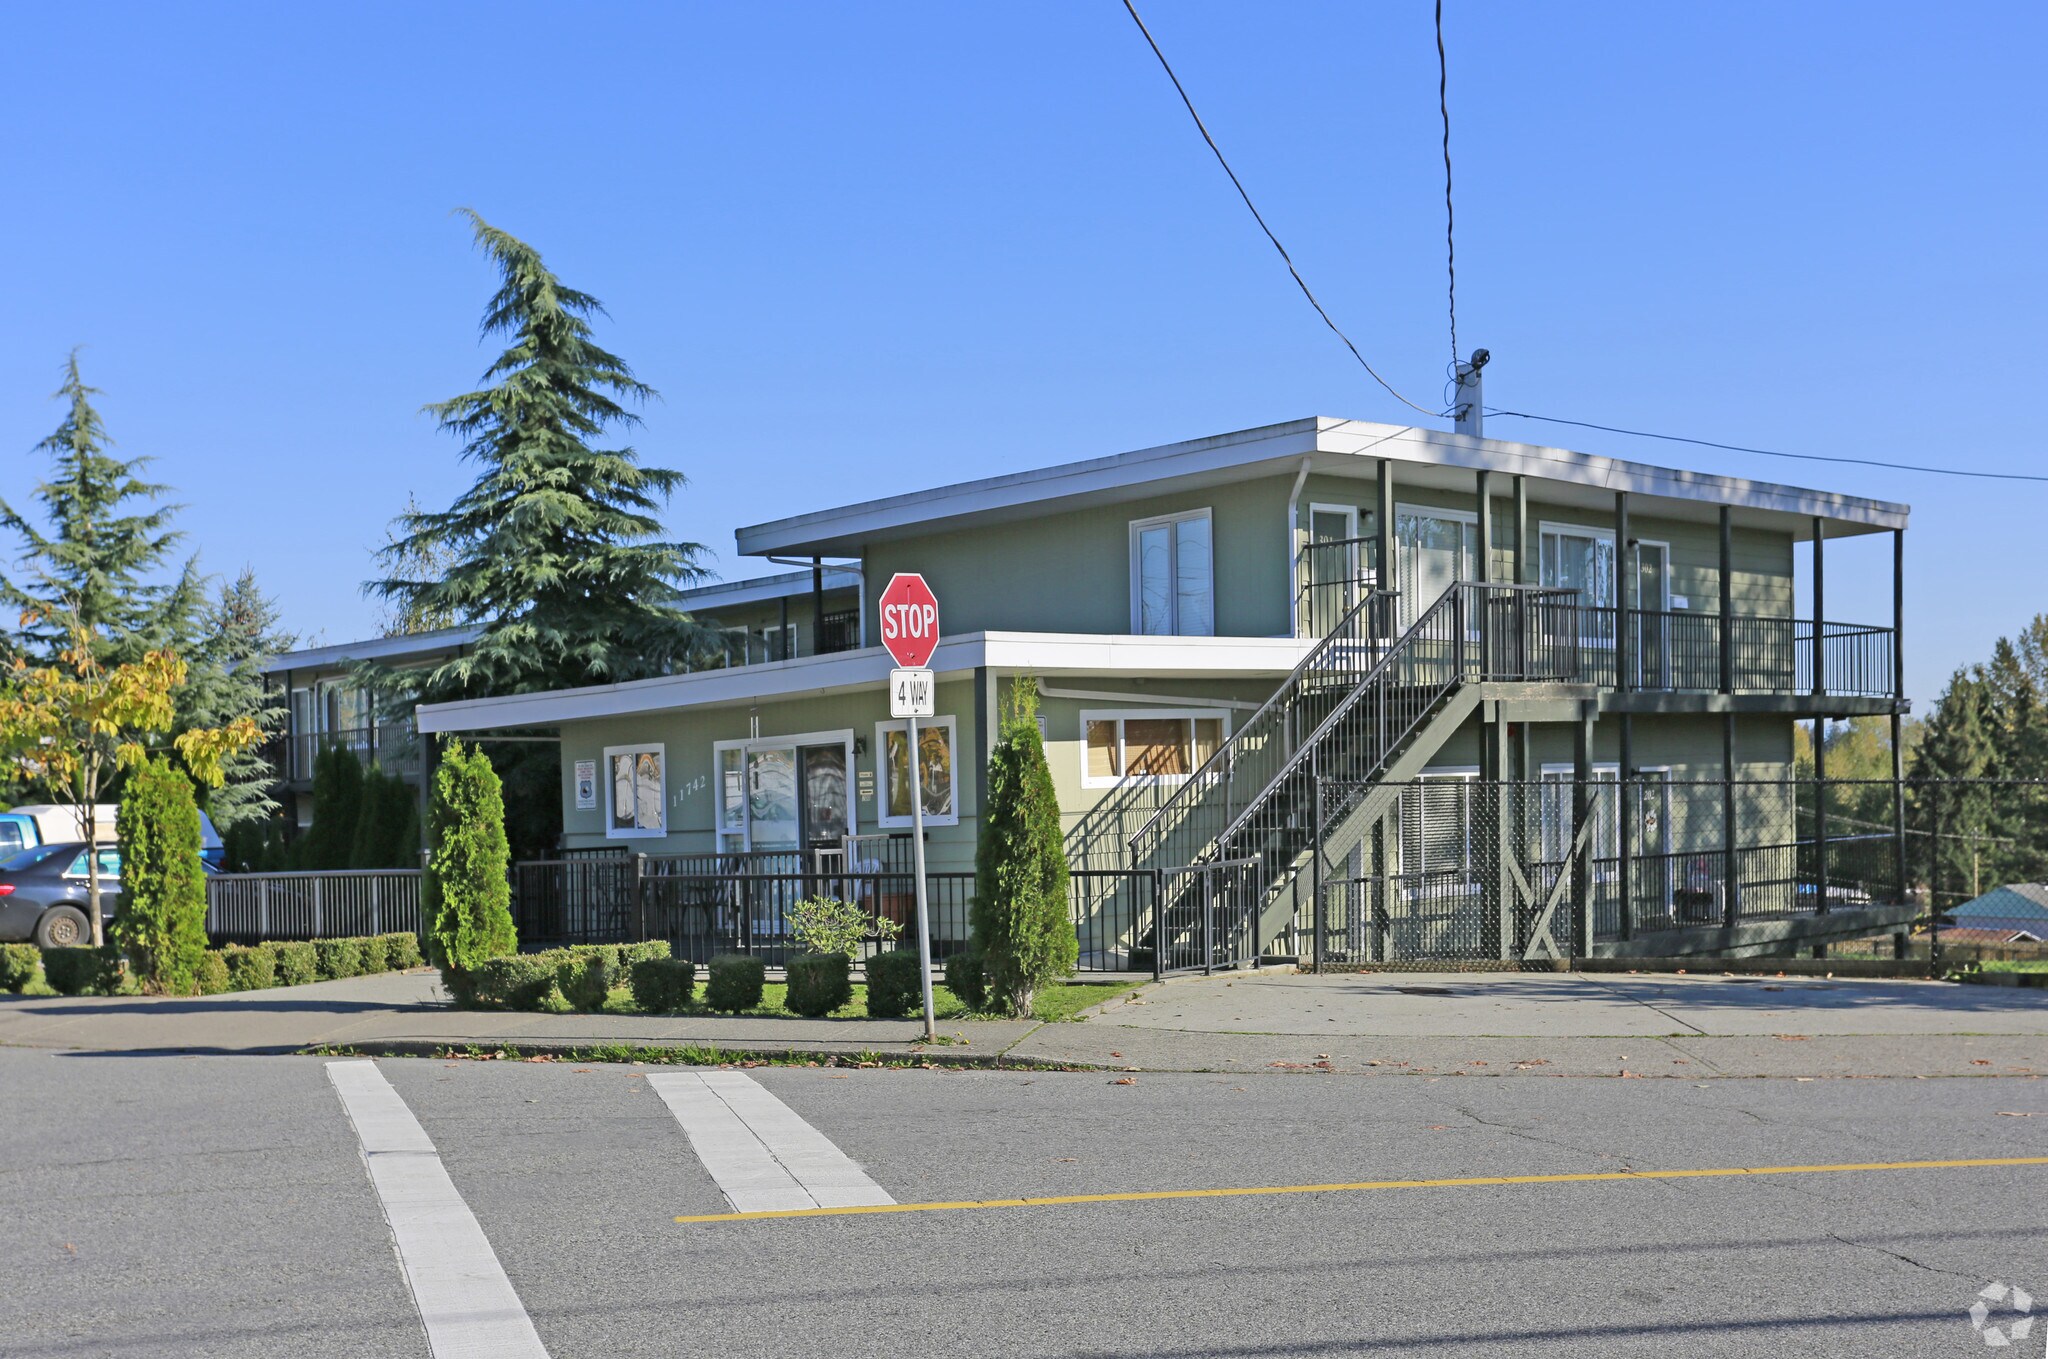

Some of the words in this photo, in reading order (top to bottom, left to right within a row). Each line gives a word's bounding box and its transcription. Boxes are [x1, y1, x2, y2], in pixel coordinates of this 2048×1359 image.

[884, 603, 936, 639] STOP
[898, 680, 906, 706] 4
[909, 680, 928, 706] WAY
[673, 775, 706, 808] 11742
